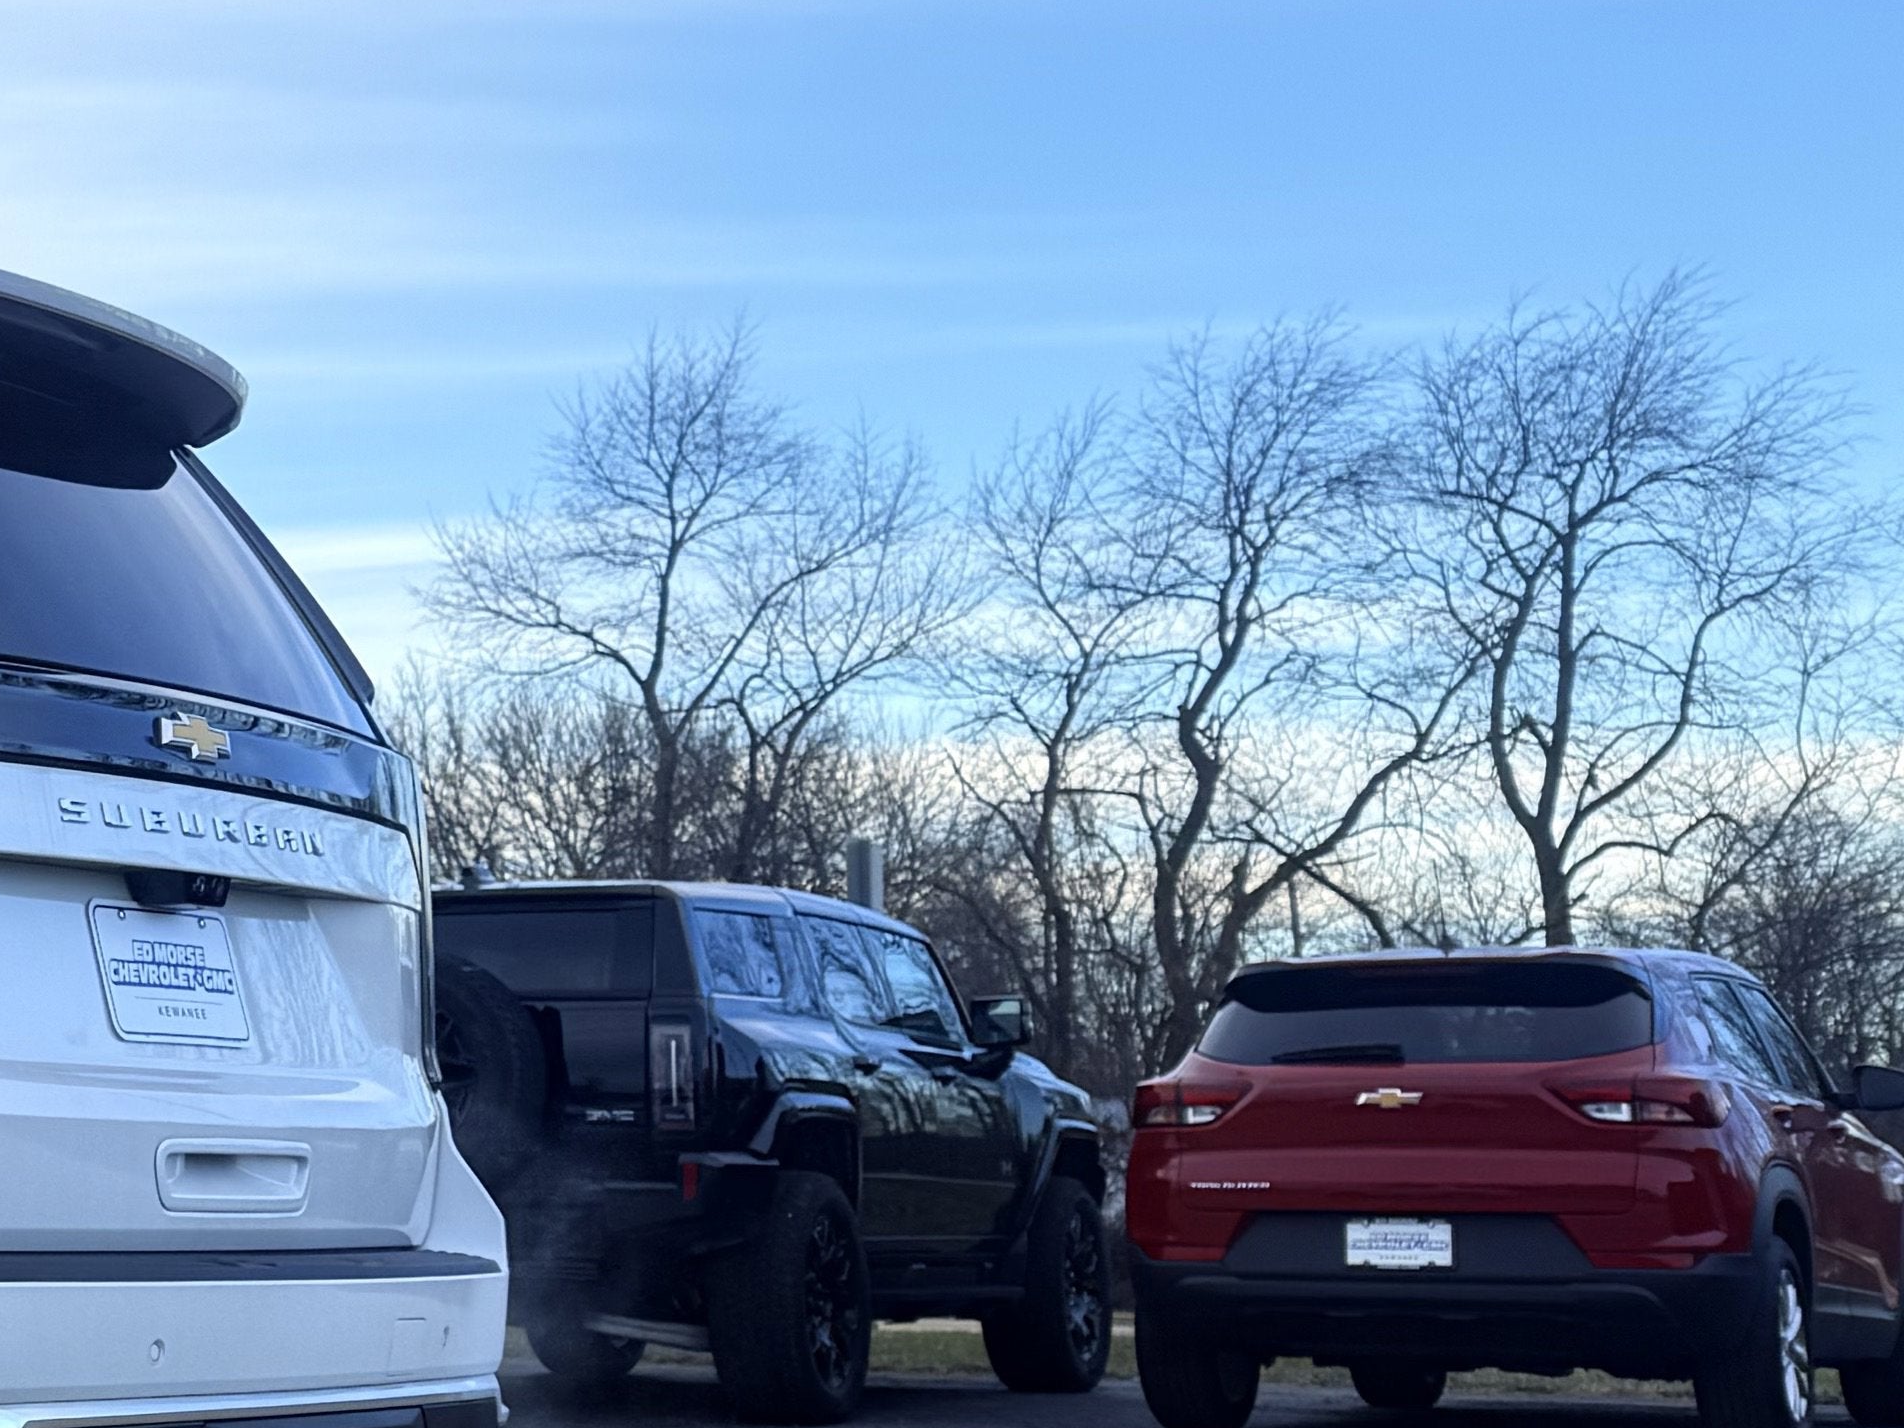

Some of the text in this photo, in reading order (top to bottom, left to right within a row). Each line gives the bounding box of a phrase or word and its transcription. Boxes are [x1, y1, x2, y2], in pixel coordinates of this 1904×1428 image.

[58, 797, 325, 857] SUBURBAN
[132, 939, 205, 968] ED MORSE
[159, 1005, 207, 1020] KEWANEE
